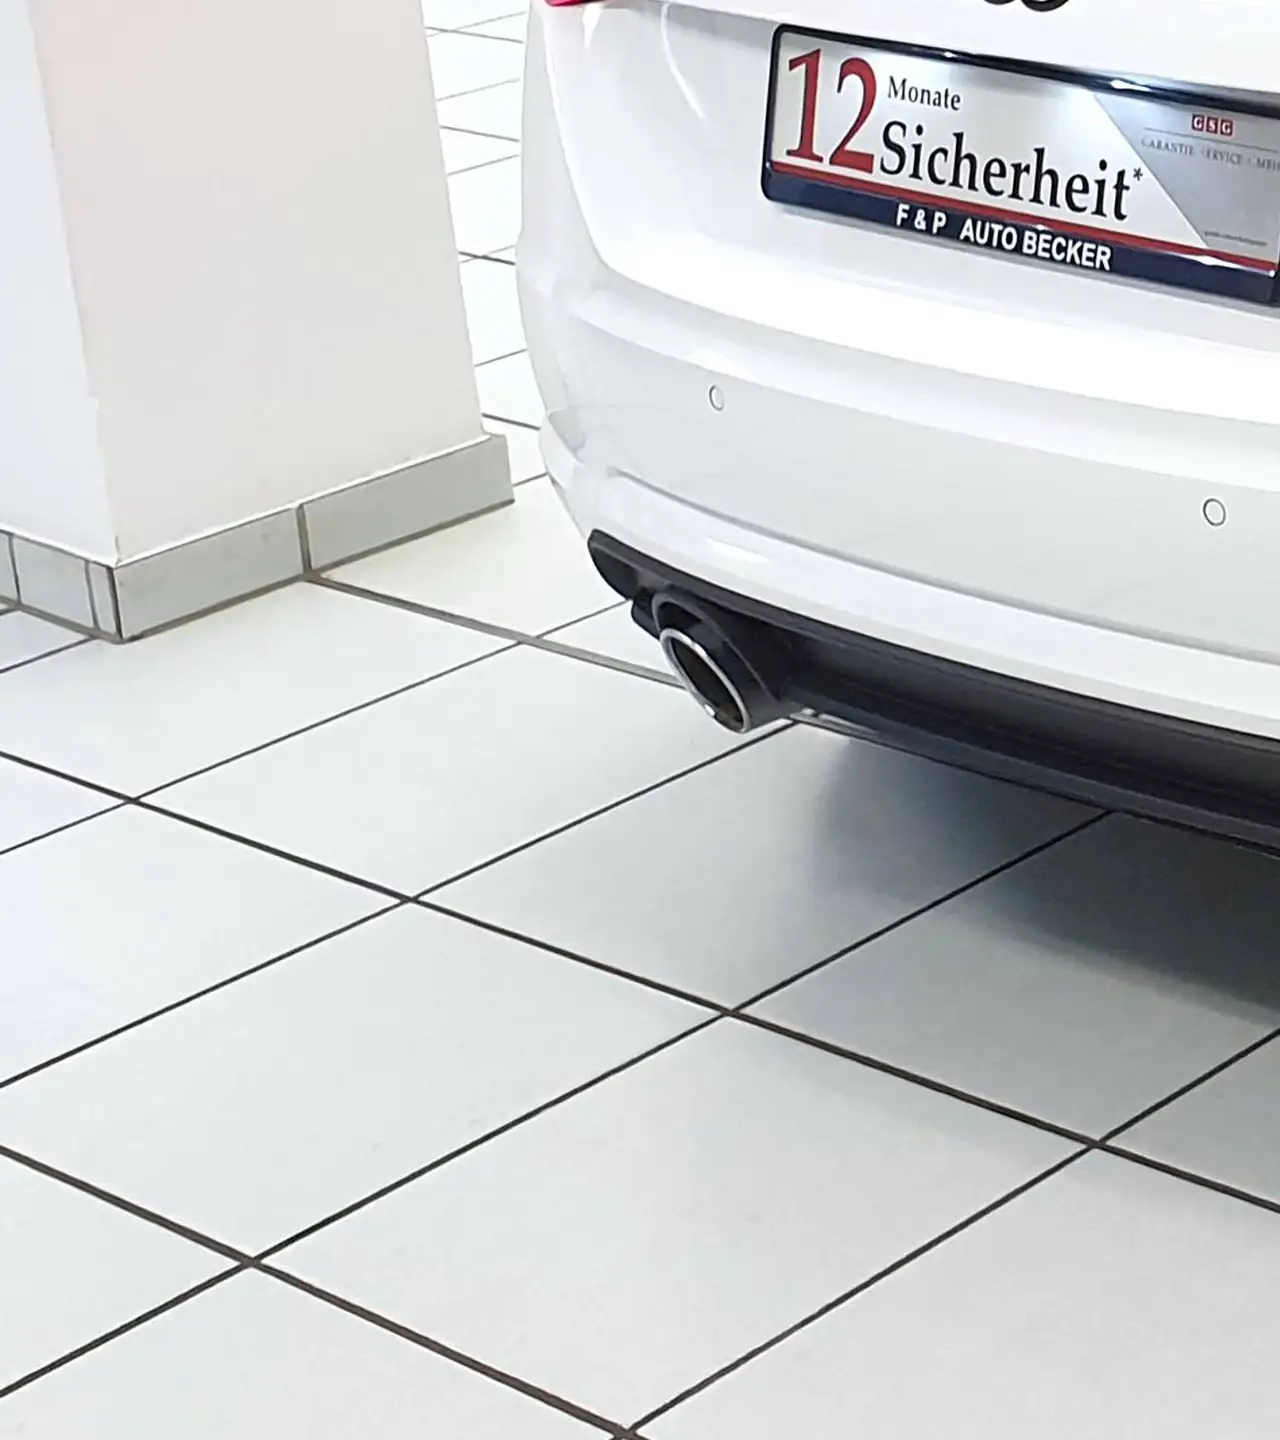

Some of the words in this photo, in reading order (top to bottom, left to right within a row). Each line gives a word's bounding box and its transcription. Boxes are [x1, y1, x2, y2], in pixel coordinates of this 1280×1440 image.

[786, 48, 877, 174] 12
[888, 75, 961, 111] Monate
[1192, 114, 1234, 137] GSG
[896, 203, 911, 227] F
[913, 209, 927, 232] &
[932, 212, 948, 235] P
[959, 217, 1018, 251] AUTO
[1021, 229, 1112, 272] BECKER
